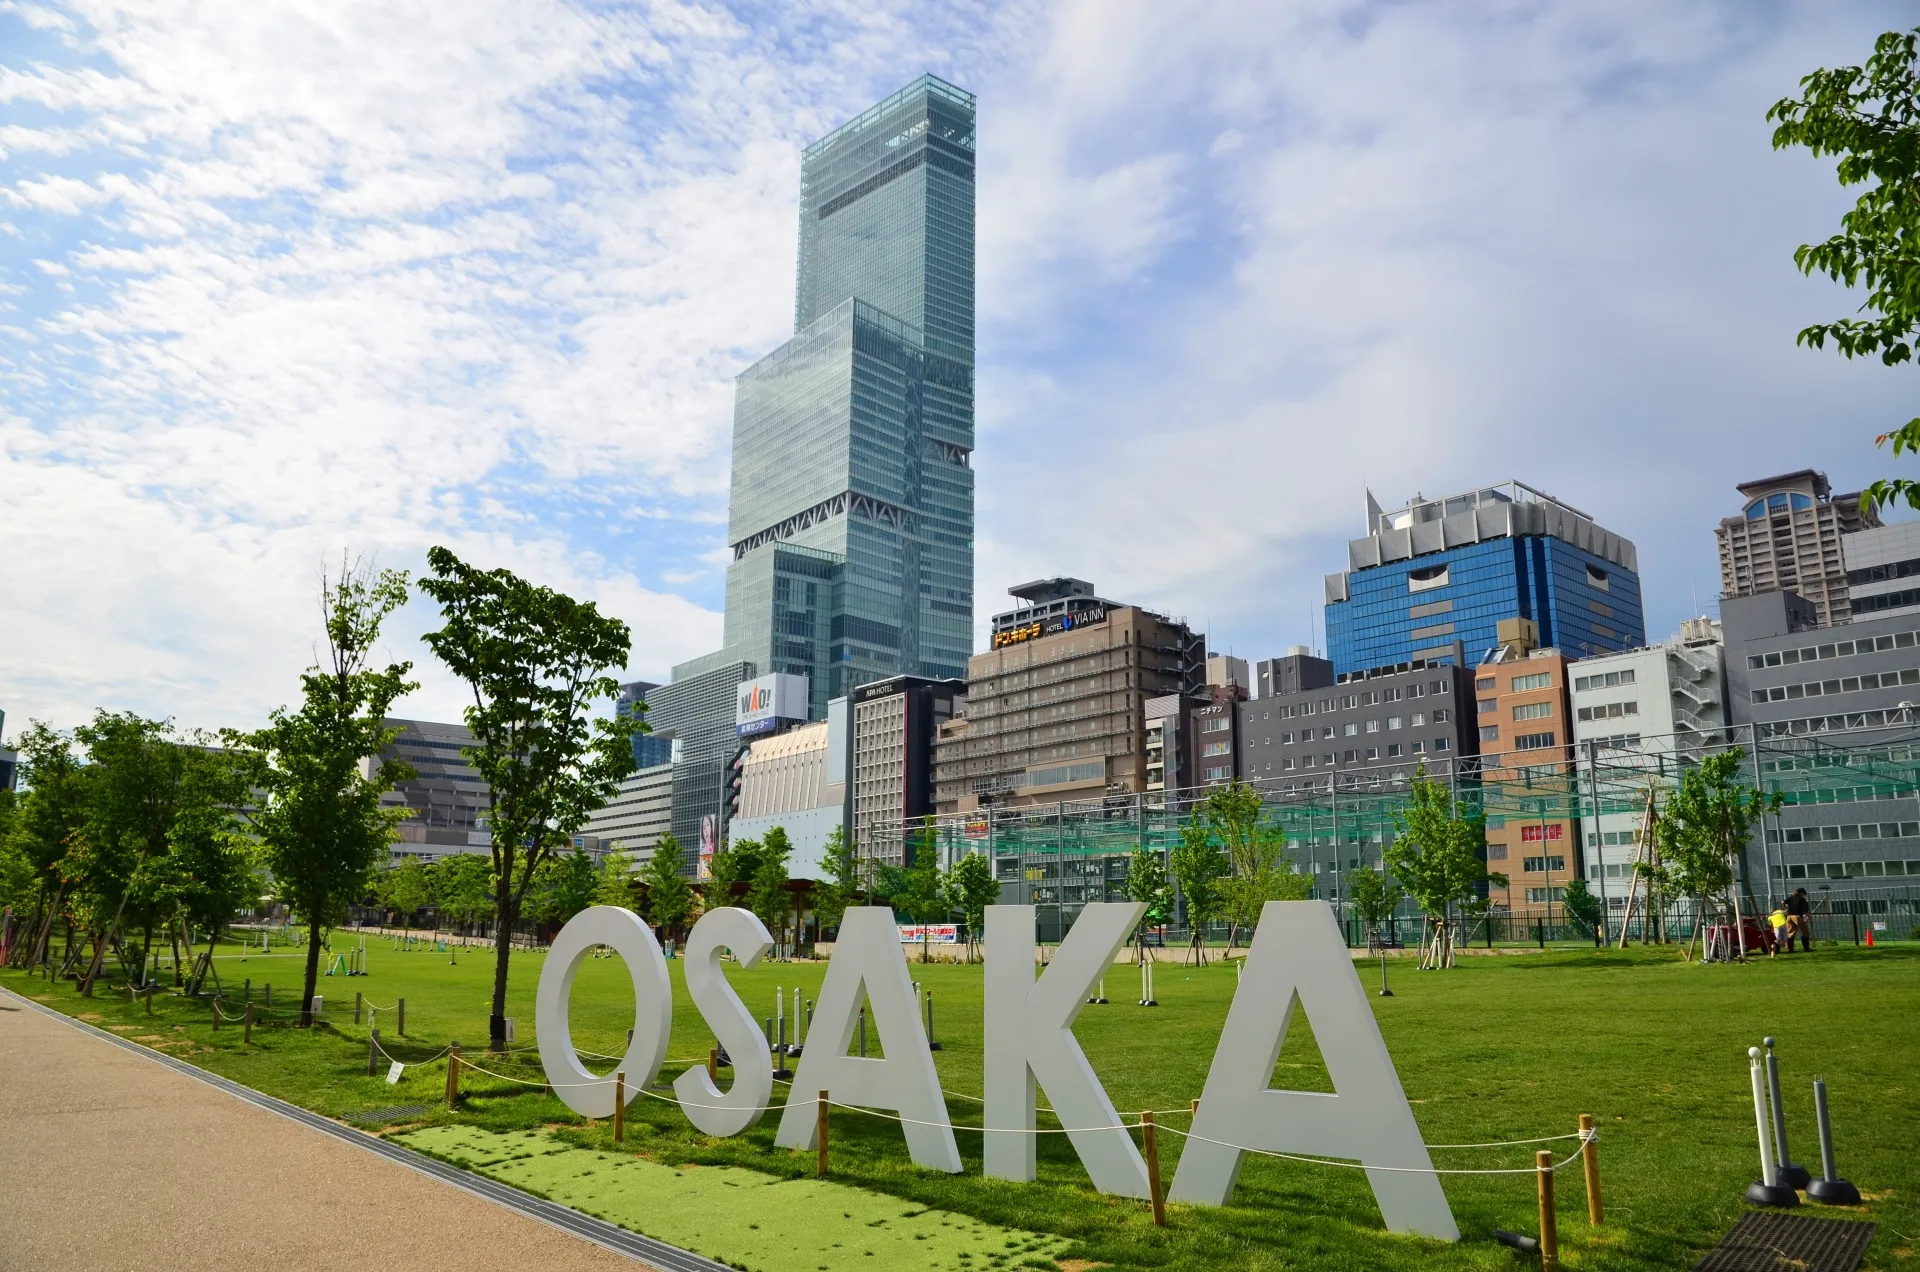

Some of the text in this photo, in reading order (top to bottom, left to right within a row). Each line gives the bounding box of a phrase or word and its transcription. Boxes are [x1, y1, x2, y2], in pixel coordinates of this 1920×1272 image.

[1046, 607, 1104, 633] HOTEL VIA INN
[877, 685, 893, 695] HOTEL
[536, 900, 1459, 1242] OSAKA
